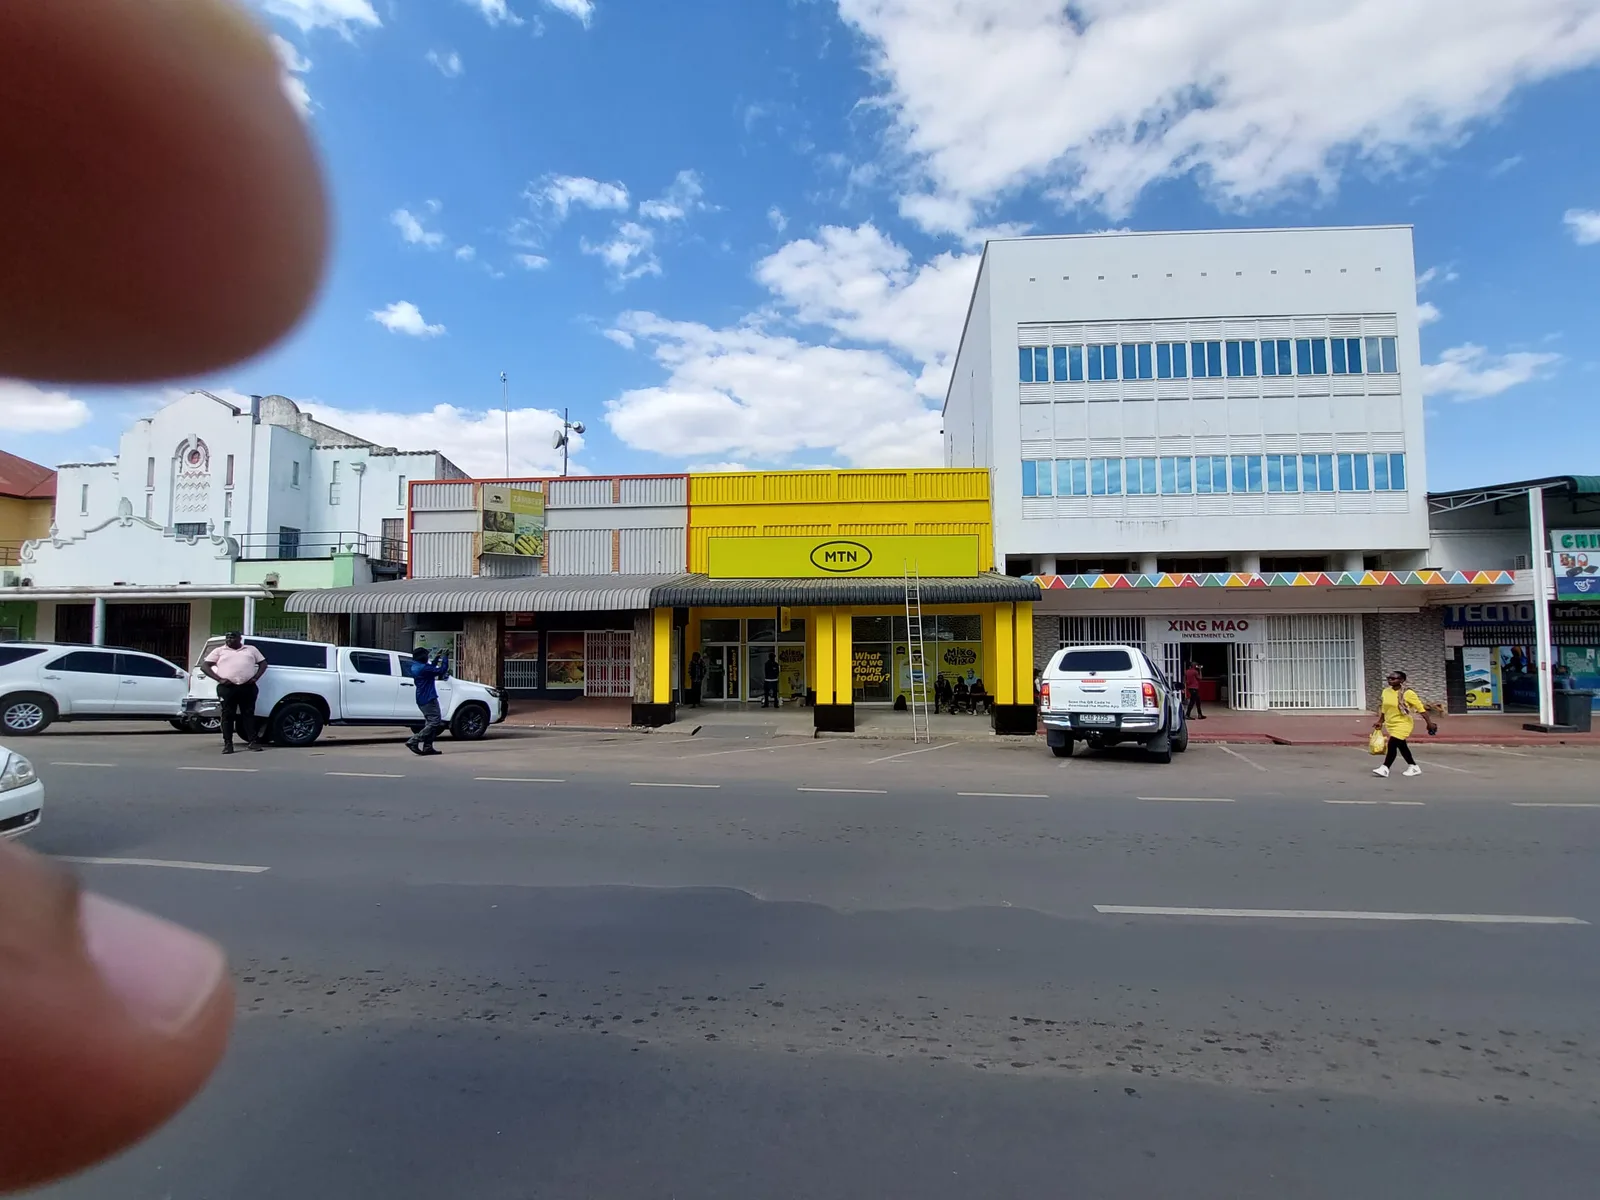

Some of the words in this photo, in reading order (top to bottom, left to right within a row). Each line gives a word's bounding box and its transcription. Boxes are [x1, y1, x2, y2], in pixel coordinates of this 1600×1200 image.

[1561, 534, 1600, 548] CHI
[825, 551, 857, 562] MTN
[1451, 604, 1534, 622] TECNO
[1555, 606, 1600, 617] Infinix
[1168, 620, 1207, 631] XING
[1211, 620, 1249, 631] MAO
[855, 652, 881, 660] What
[854, 665, 883, 675] doing
[856, 673, 891, 683] today?
